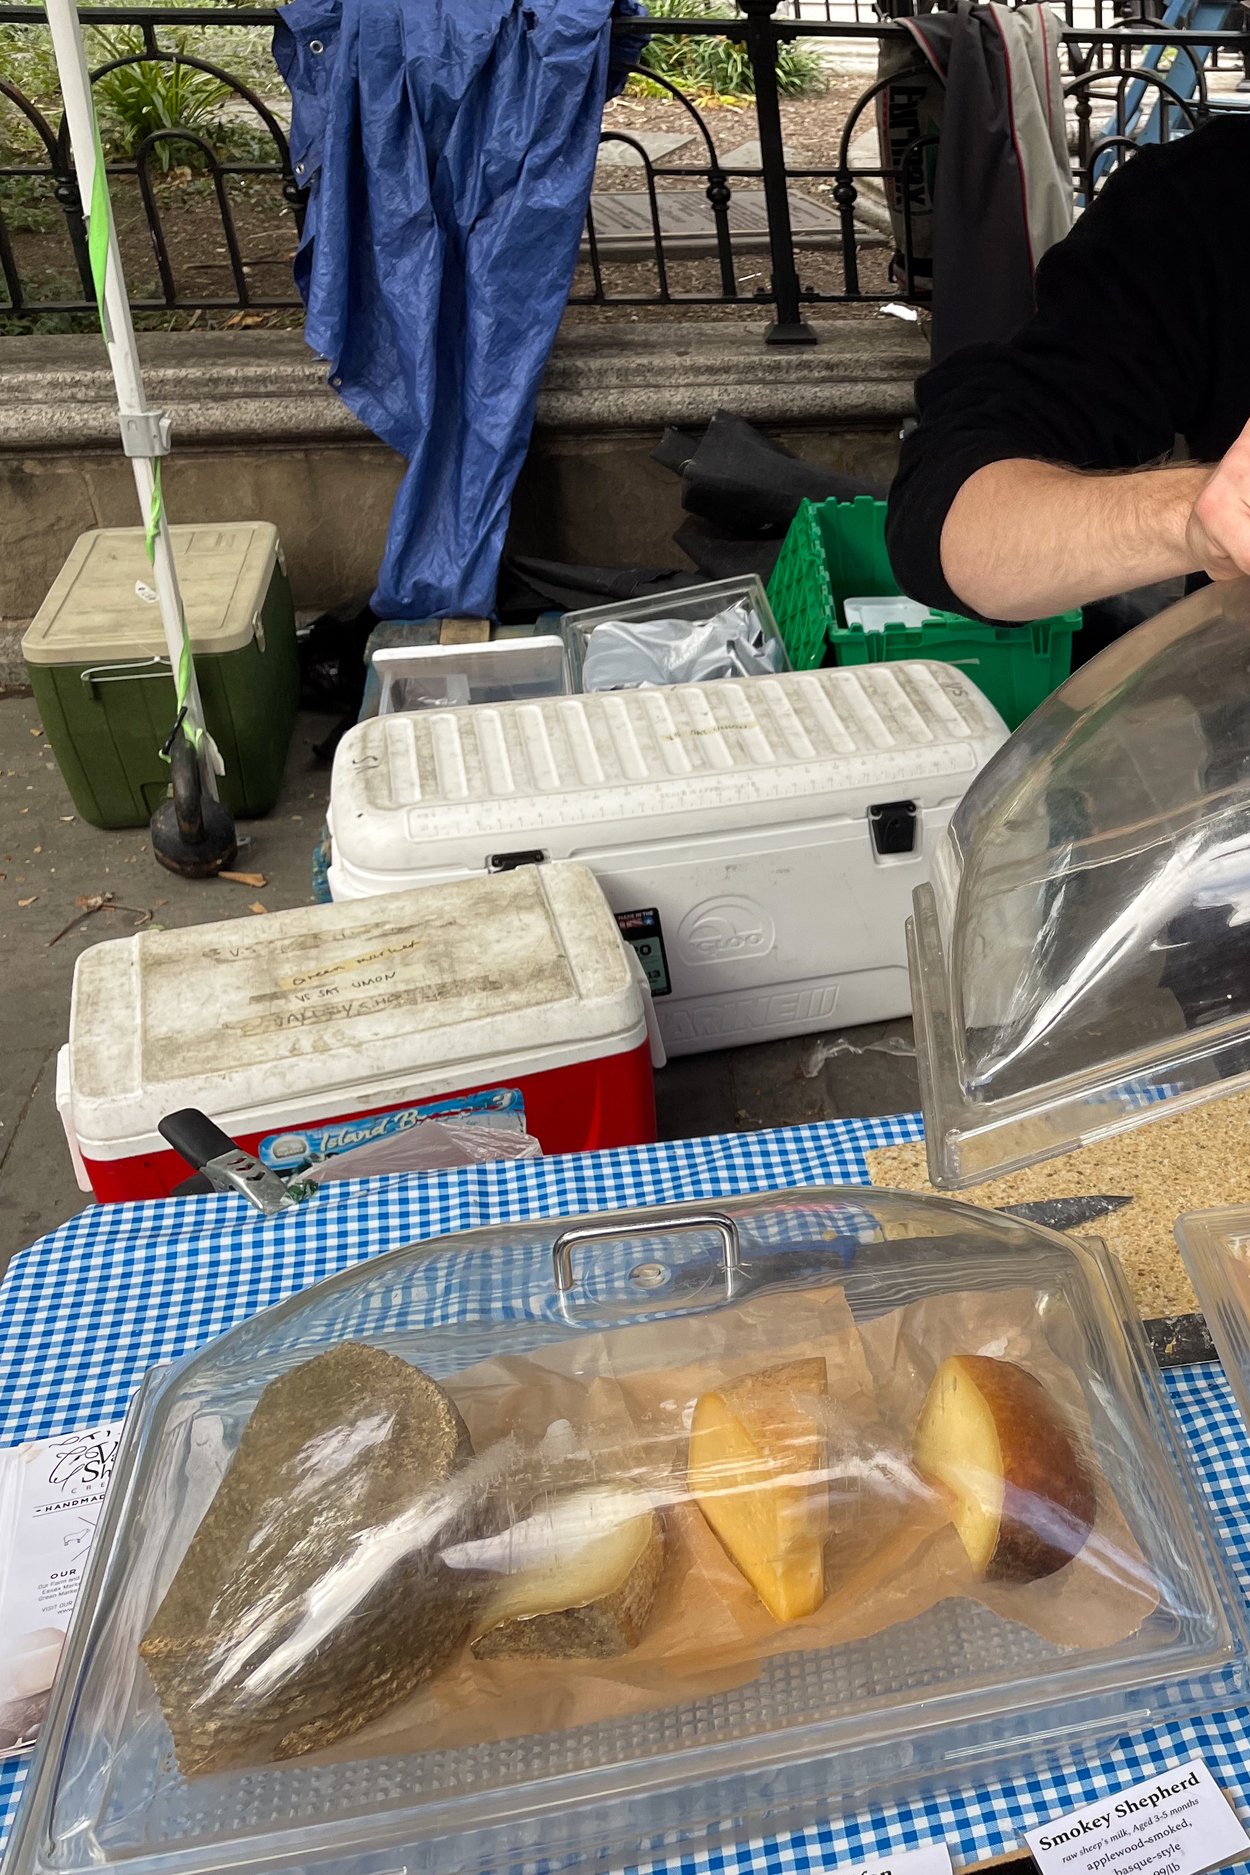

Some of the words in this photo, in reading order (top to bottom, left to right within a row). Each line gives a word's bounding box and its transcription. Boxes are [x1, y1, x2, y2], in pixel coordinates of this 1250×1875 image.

[319, 1115, 396, 1152] Island
[50, 1568, 77, 1580] OUR
[1039, 1812, 1112, 1851] Smokey
[1114, 1771, 1201, 1819] Shepherd
[1062, 1852, 1078, 1864] raw
[1079, 1837, 1109, 1857] sheep's
[1110, 1829, 1132, 1843] milk,
[1133, 1818, 1154, 1835] Aged
[1154, 1812, 1169, 1823] 3-5
[1169, 1797, 1200, 1816] months
[1086, 1819, 1194, 1872] applewood-smoked,
[1113, 1843, 1182, 1875] basque-style
